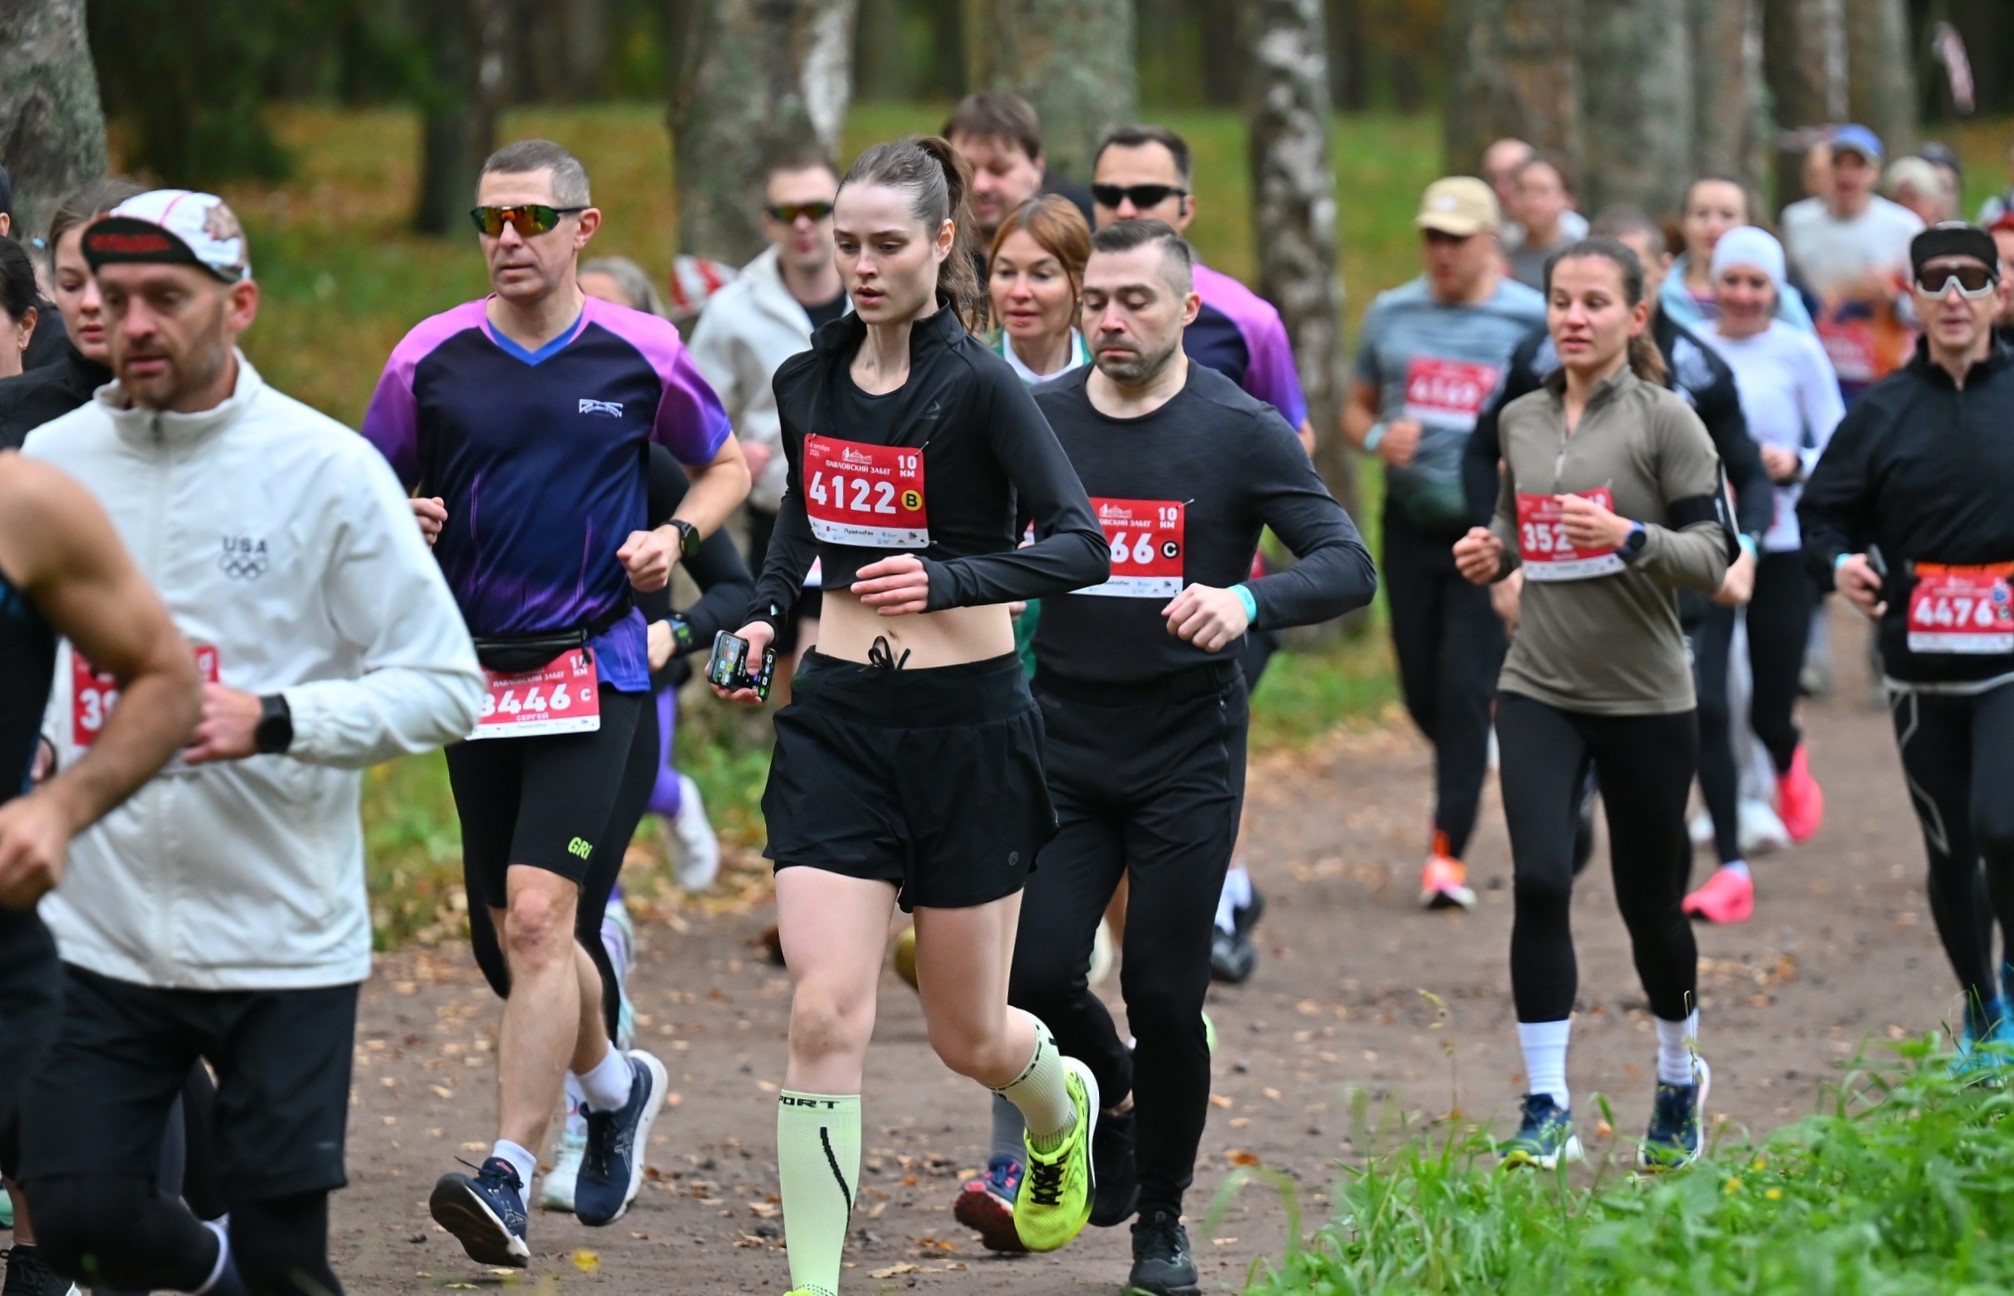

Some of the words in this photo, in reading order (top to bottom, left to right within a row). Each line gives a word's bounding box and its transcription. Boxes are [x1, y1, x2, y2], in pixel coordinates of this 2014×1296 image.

[825, 459, 870, 473] ПАВЛОВСКИЙ
[870, 467, 892, 475] ЗАБЕГ
[897, 454, 918, 470] 10
[899, 469, 916, 478] КМ
[809, 471, 897, 514] 4122
[906, 493, 918, 507] B
[1158, 506, 1178, 521] 10
[1130, 519, 1152, 528] ЗАБЕГ
[1159, 520, 1176, 529] КМ
[222, 536, 268, 554] USA
[1162, 542, 1178, 558] C
[1913, 596, 1994, 628] 4476
[544, 671, 565, 681] ЗАБЕГ
[573, 667, 588, 678] КМ
[516, 712, 549, 722] СЕРГЕЙ
